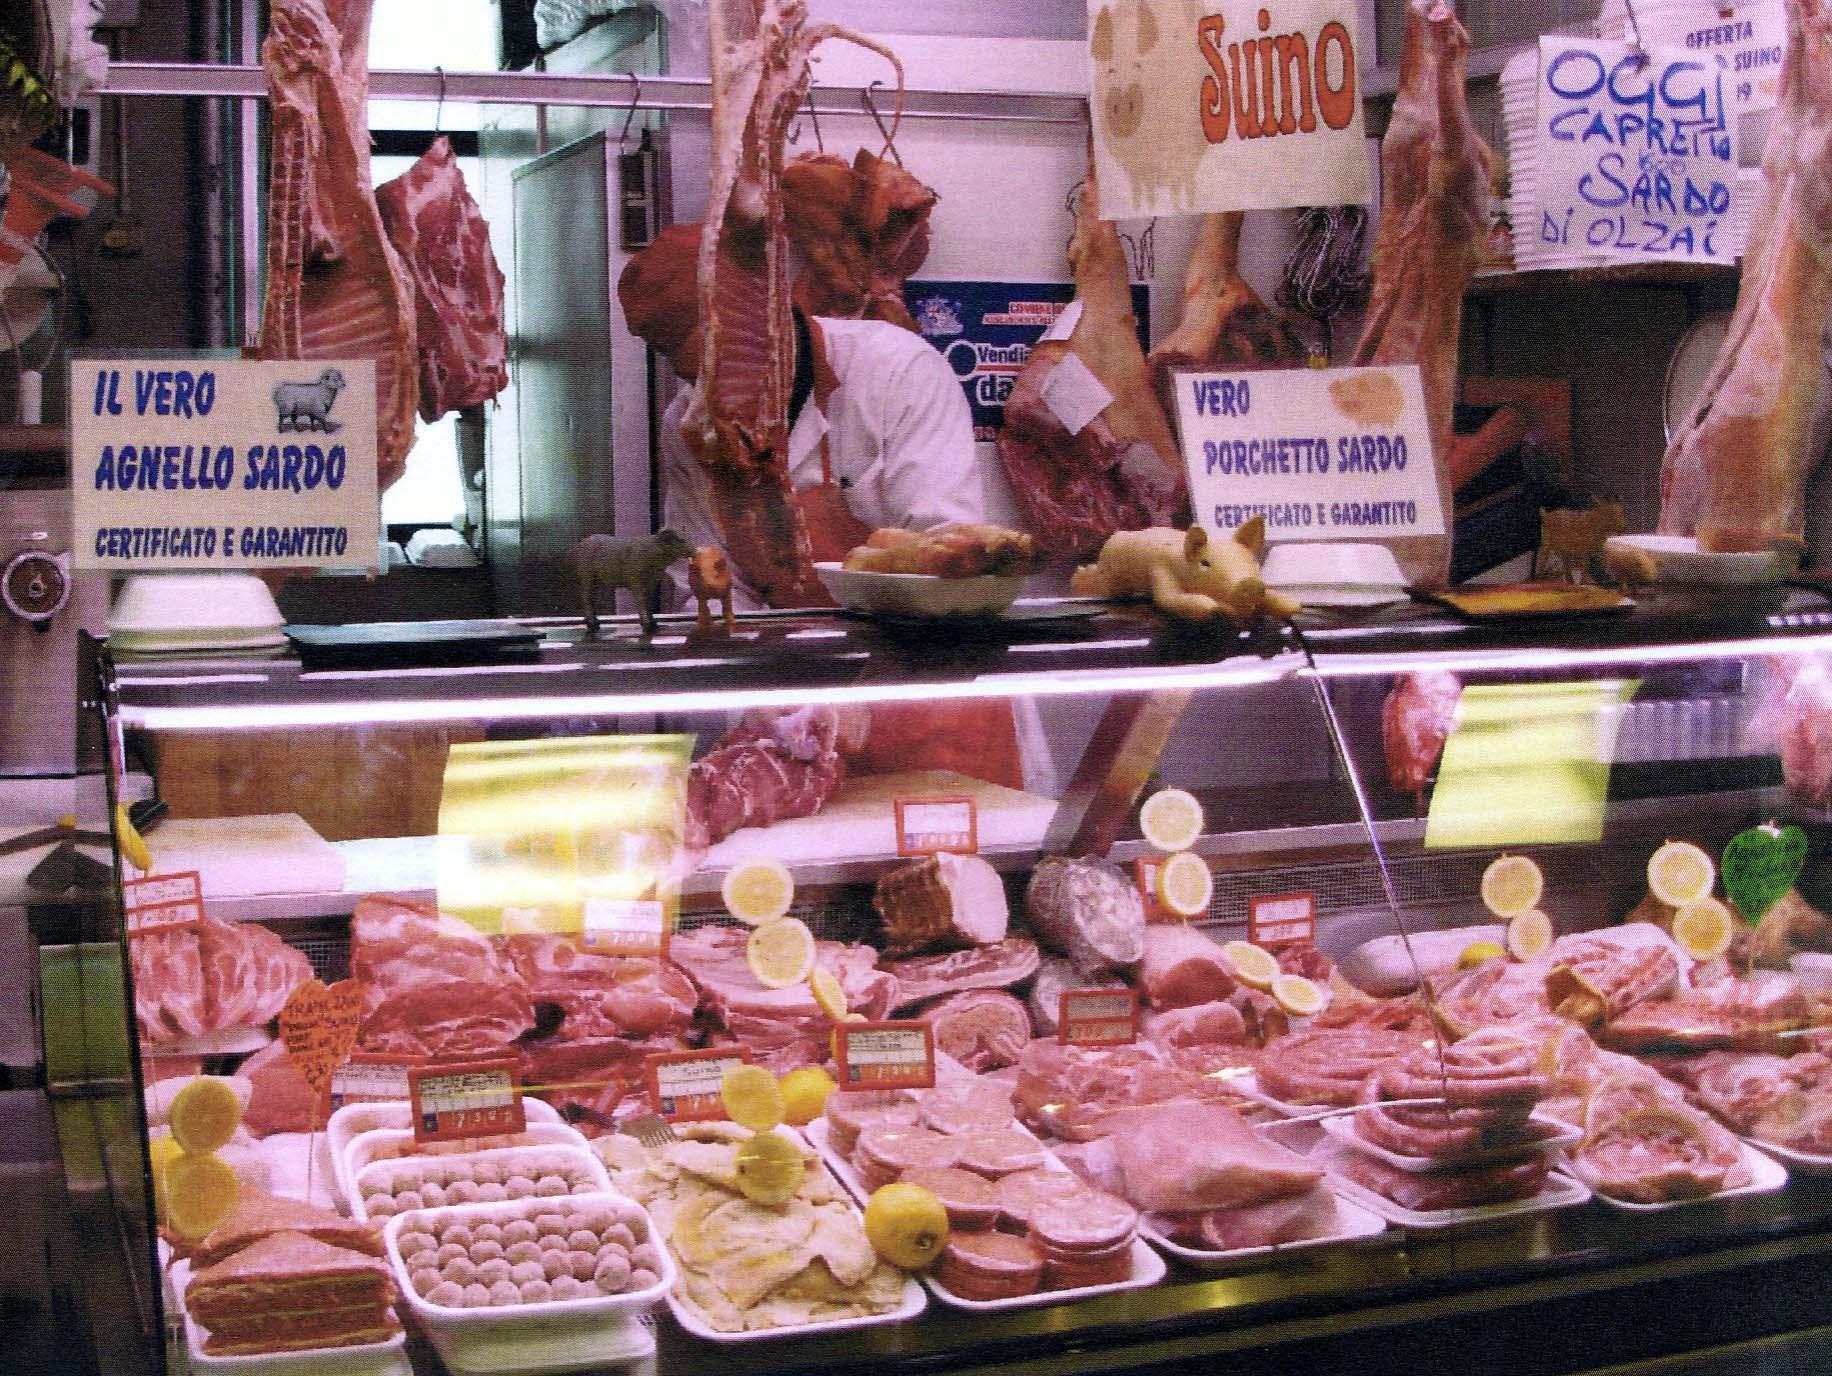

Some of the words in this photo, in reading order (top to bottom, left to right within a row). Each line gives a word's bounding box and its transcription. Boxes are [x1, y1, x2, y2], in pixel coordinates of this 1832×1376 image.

[1686, 21, 1753, 48] OFFERTA
[1198, 8, 1355, 144] Suino
[1734, 46, 1782, 71] SUINO
[1578, 152, 1731, 215] SARDO
[93, 370, 122, 416] IL
[135, 370, 215, 418] VERO
[1193, 380, 1250, 417] VERO
[95, 445, 234, 491] AGNELLO
[243, 445, 347, 493] SARDO
[1203, 438, 1330, 476] PORCHETTO
[1337, 435, 1408, 473] SARDO
[1317, 502, 1326, 526] E
[1330, 501, 1416, 526] GARANTITO
[95, 527, 216, 558] CERTIFICATO
[223, 527, 234, 556] E
[240, 527, 348, 557] GARANTITO
